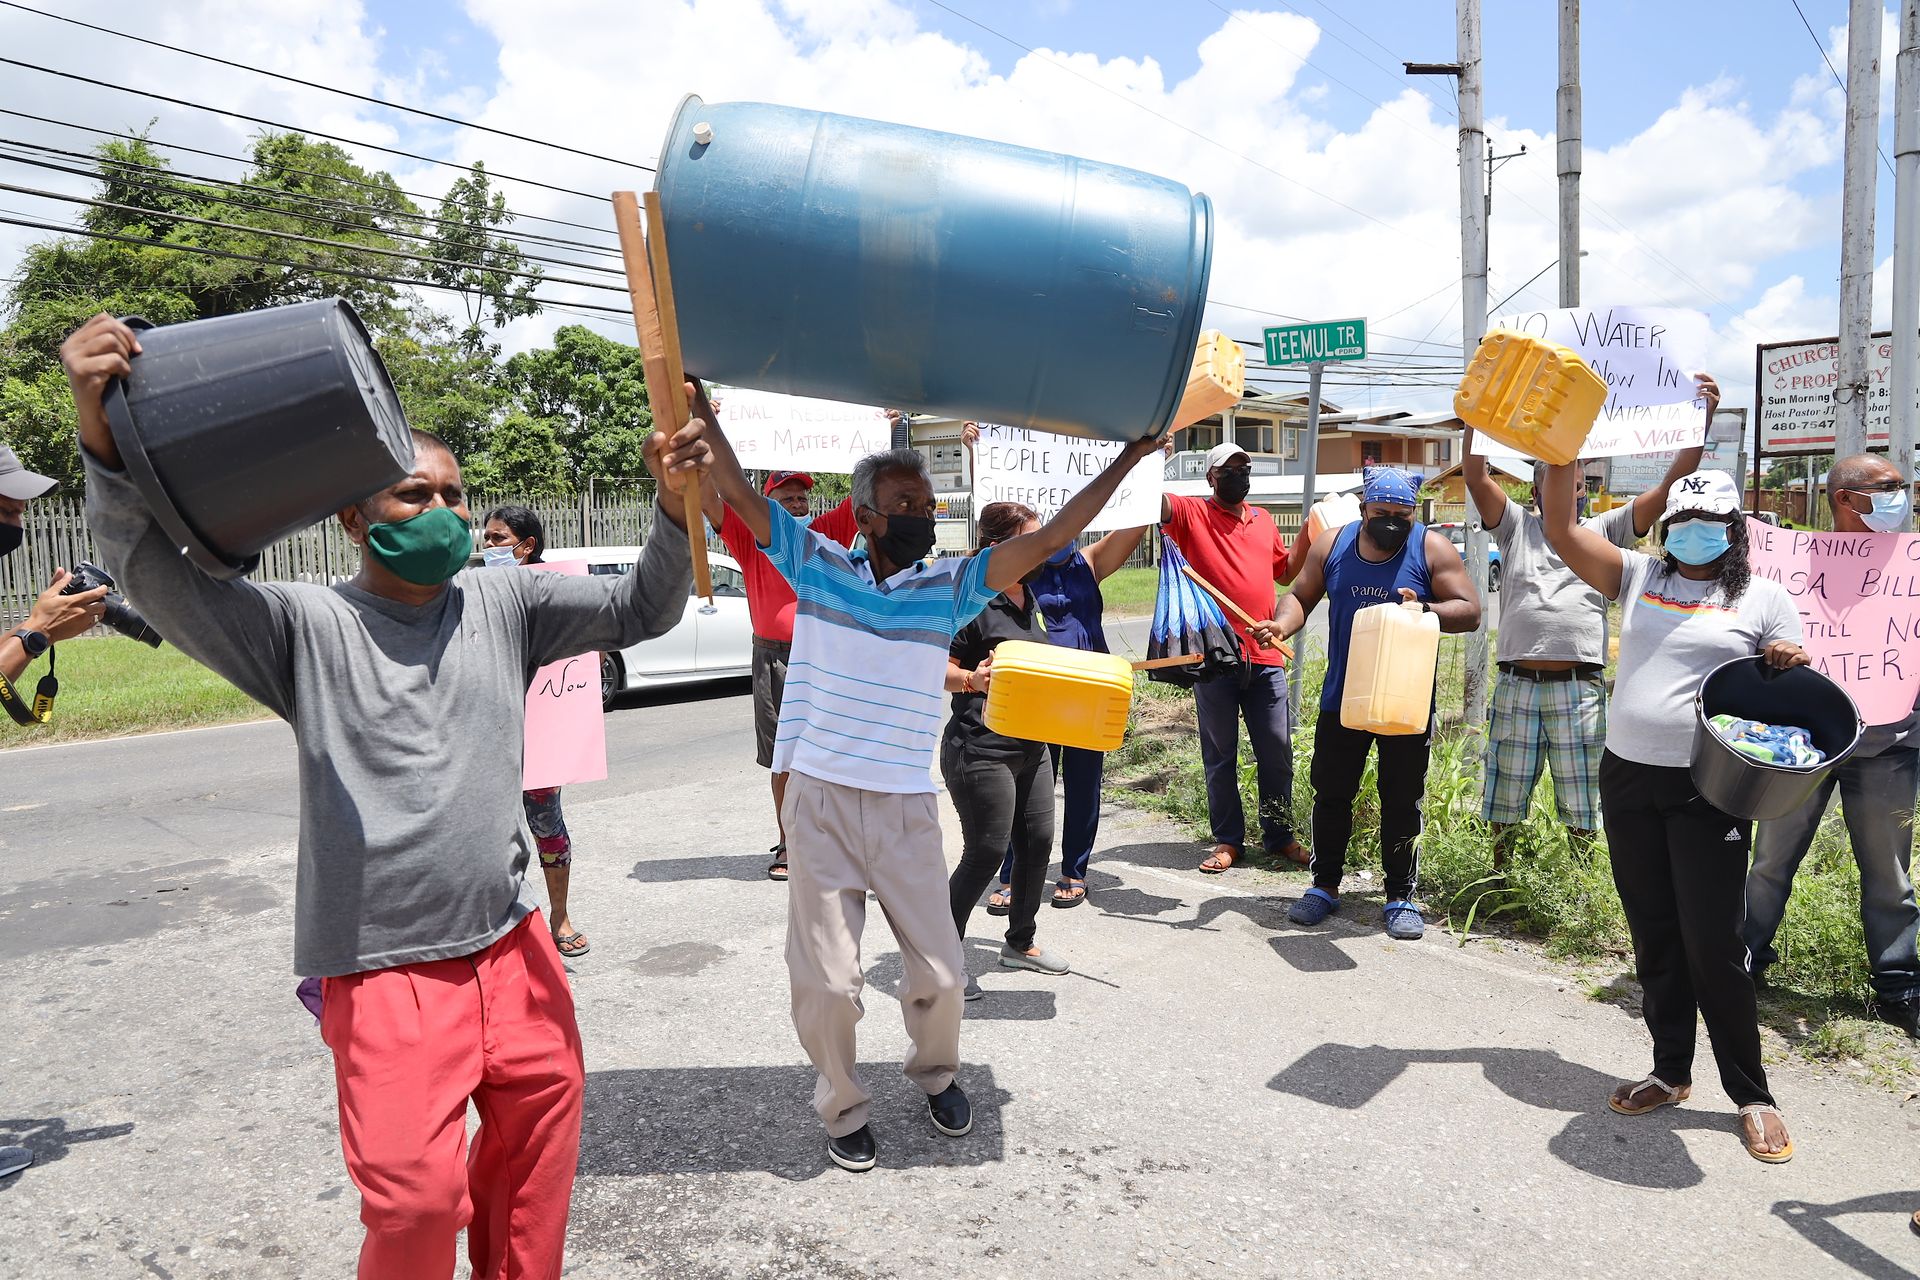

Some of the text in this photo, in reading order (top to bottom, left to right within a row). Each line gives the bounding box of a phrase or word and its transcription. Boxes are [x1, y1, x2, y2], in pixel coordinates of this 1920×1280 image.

[1569, 309, 1667, 349] WATER
[1267, 326, 1360, 361] TEEMUL TR.
[1657, 355, 1680, 388] IN
[1768, 396, 1786, 405] Sun
[1789, 393, 1830, 404] Morning
[1764, 409, 1786, 419] Host
[1788, 408, 1820, 418] Pastor
[1771, 419, 1836, 431] 480-7547
[773, 428, 841, 456] MATTER
[976, 442, 1051, 474] PEOPLE
[979, 477, 1073, 506] SUFFERED
[1680, 476, 1711, 494] NY
[1792, 532, 1875, 558] PAYING
[1351, 585, 1389, 600] Panda
[1799, 611, 1852, 638] TILL
